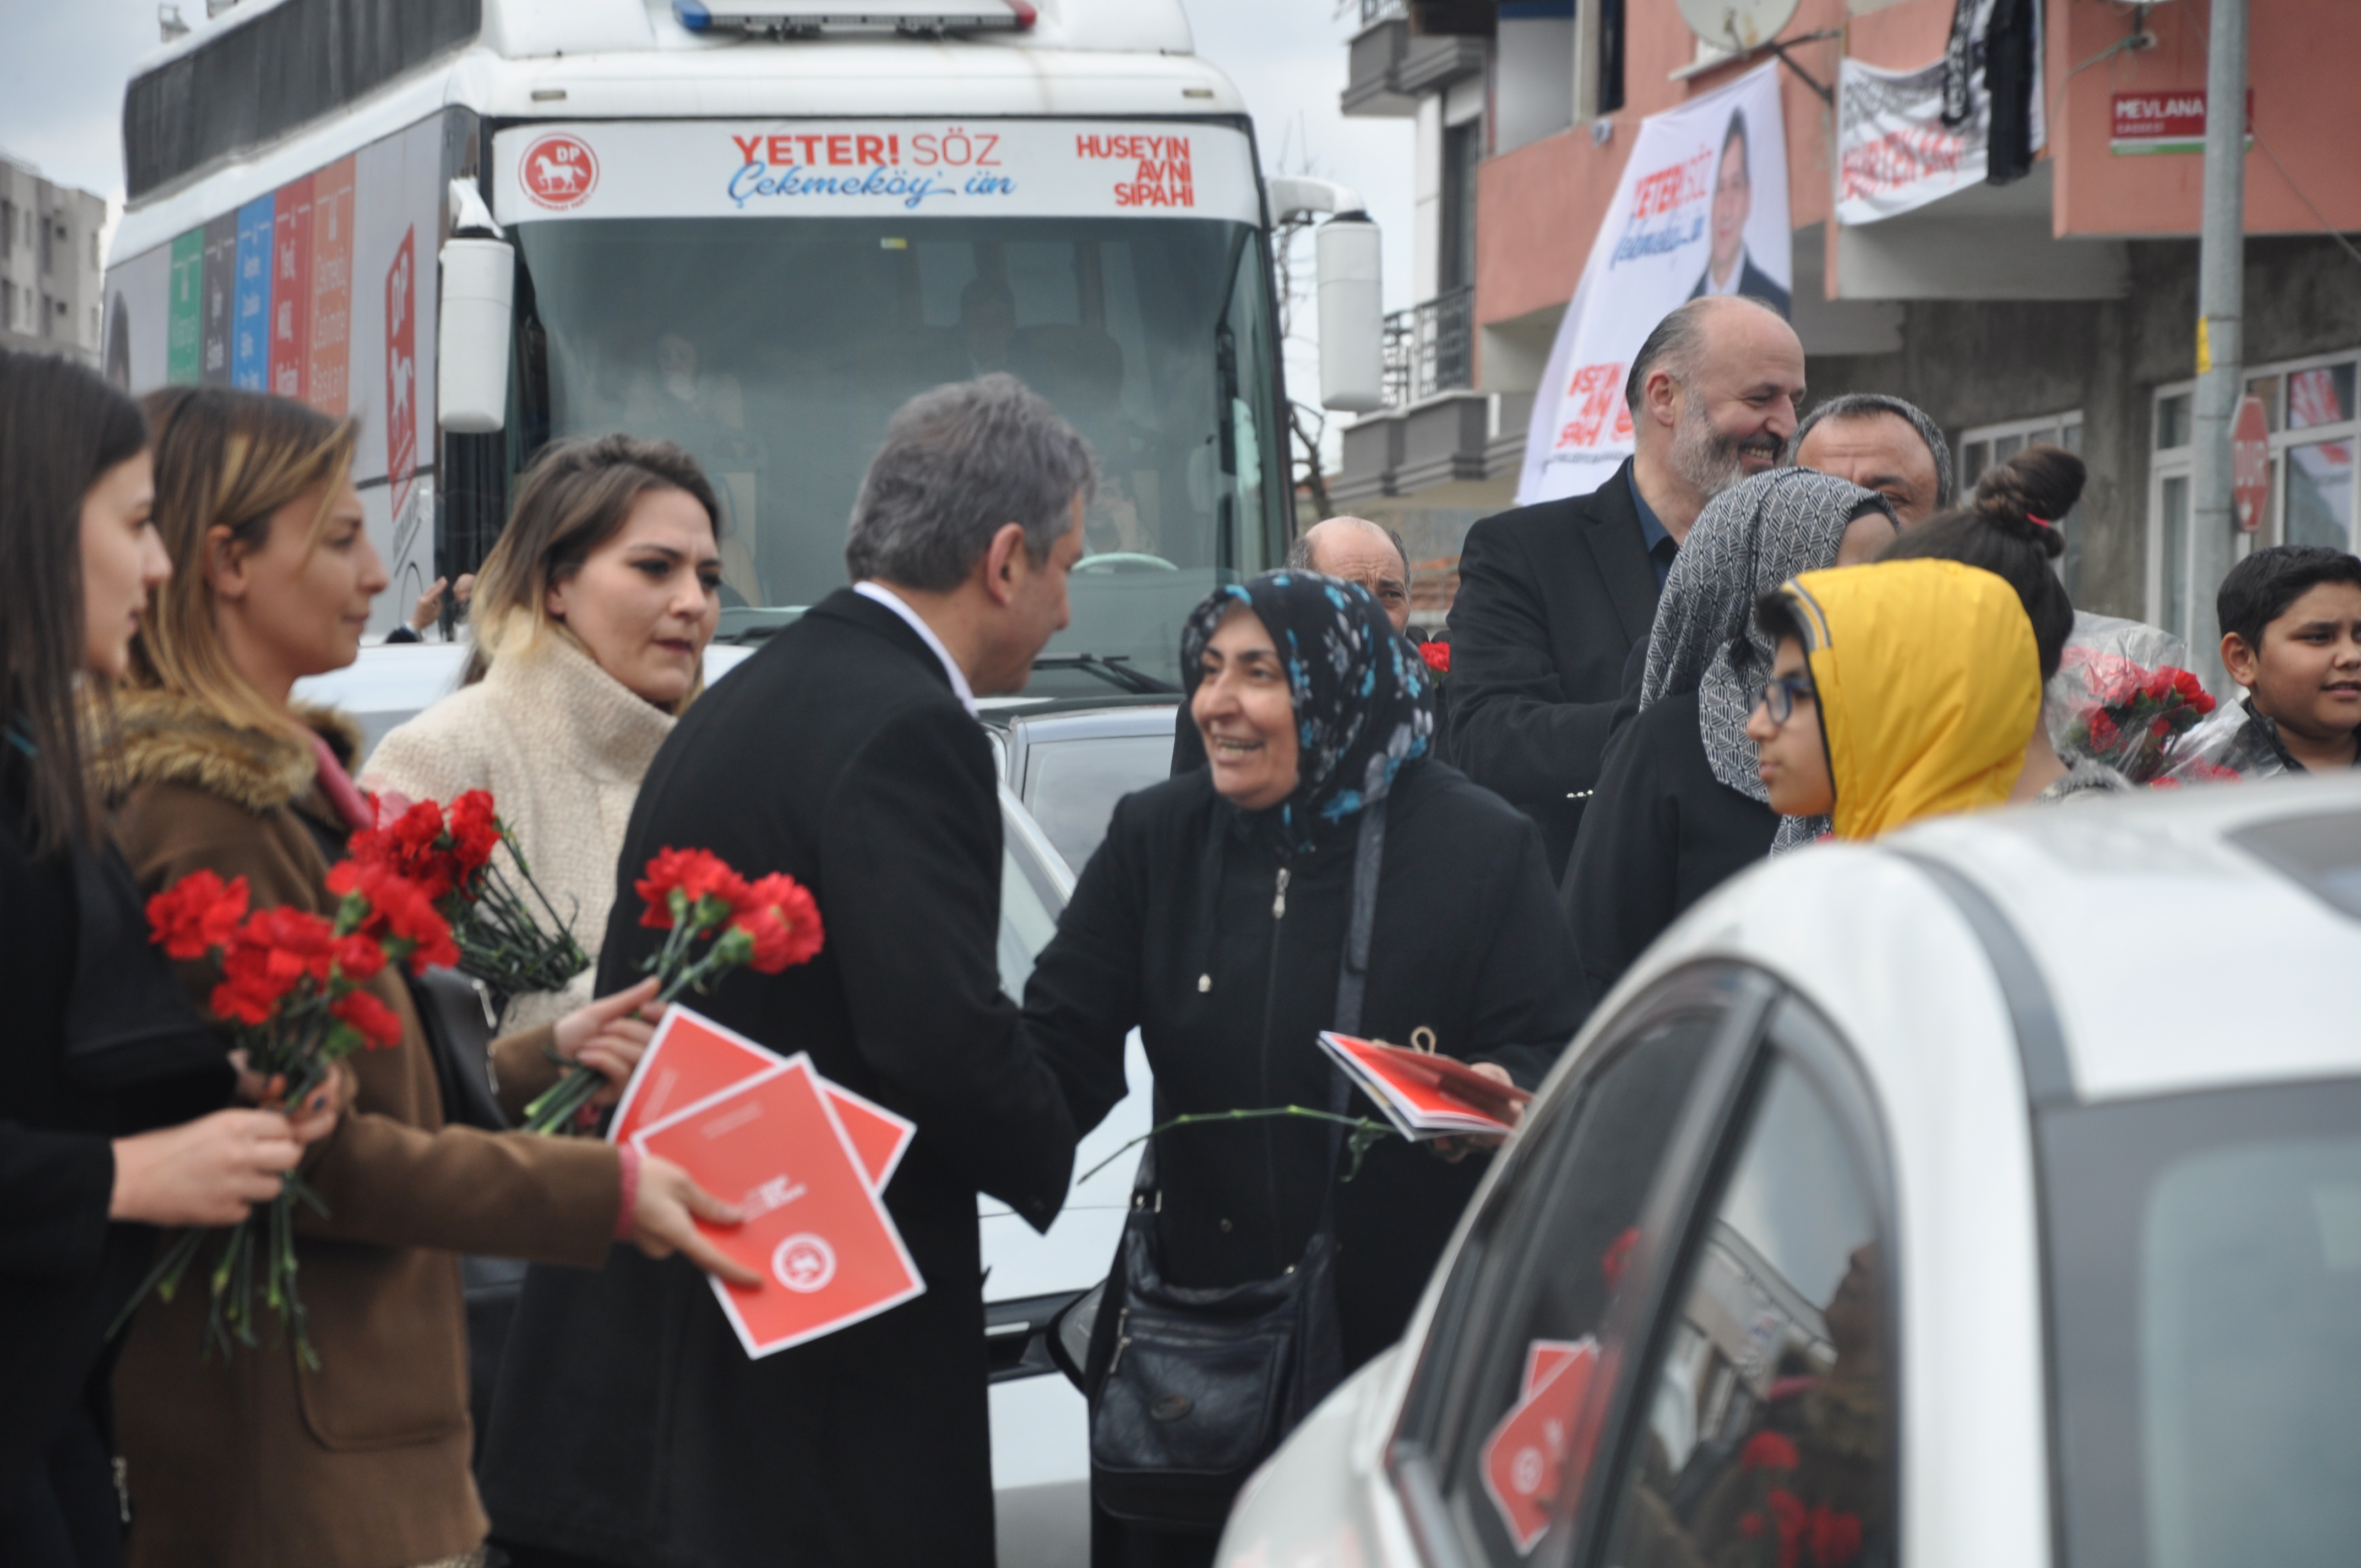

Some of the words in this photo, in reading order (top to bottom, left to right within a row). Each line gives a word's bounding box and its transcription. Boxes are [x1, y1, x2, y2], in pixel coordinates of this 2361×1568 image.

[2116, 98, 2205, 119] MEVLANA
[556, 145, 581, 163] DP
[731, 134, 900, 166] YETER!
[912, 127, 1002, 166] SÖZ
[2234, 441, 2268, 488] DUR
